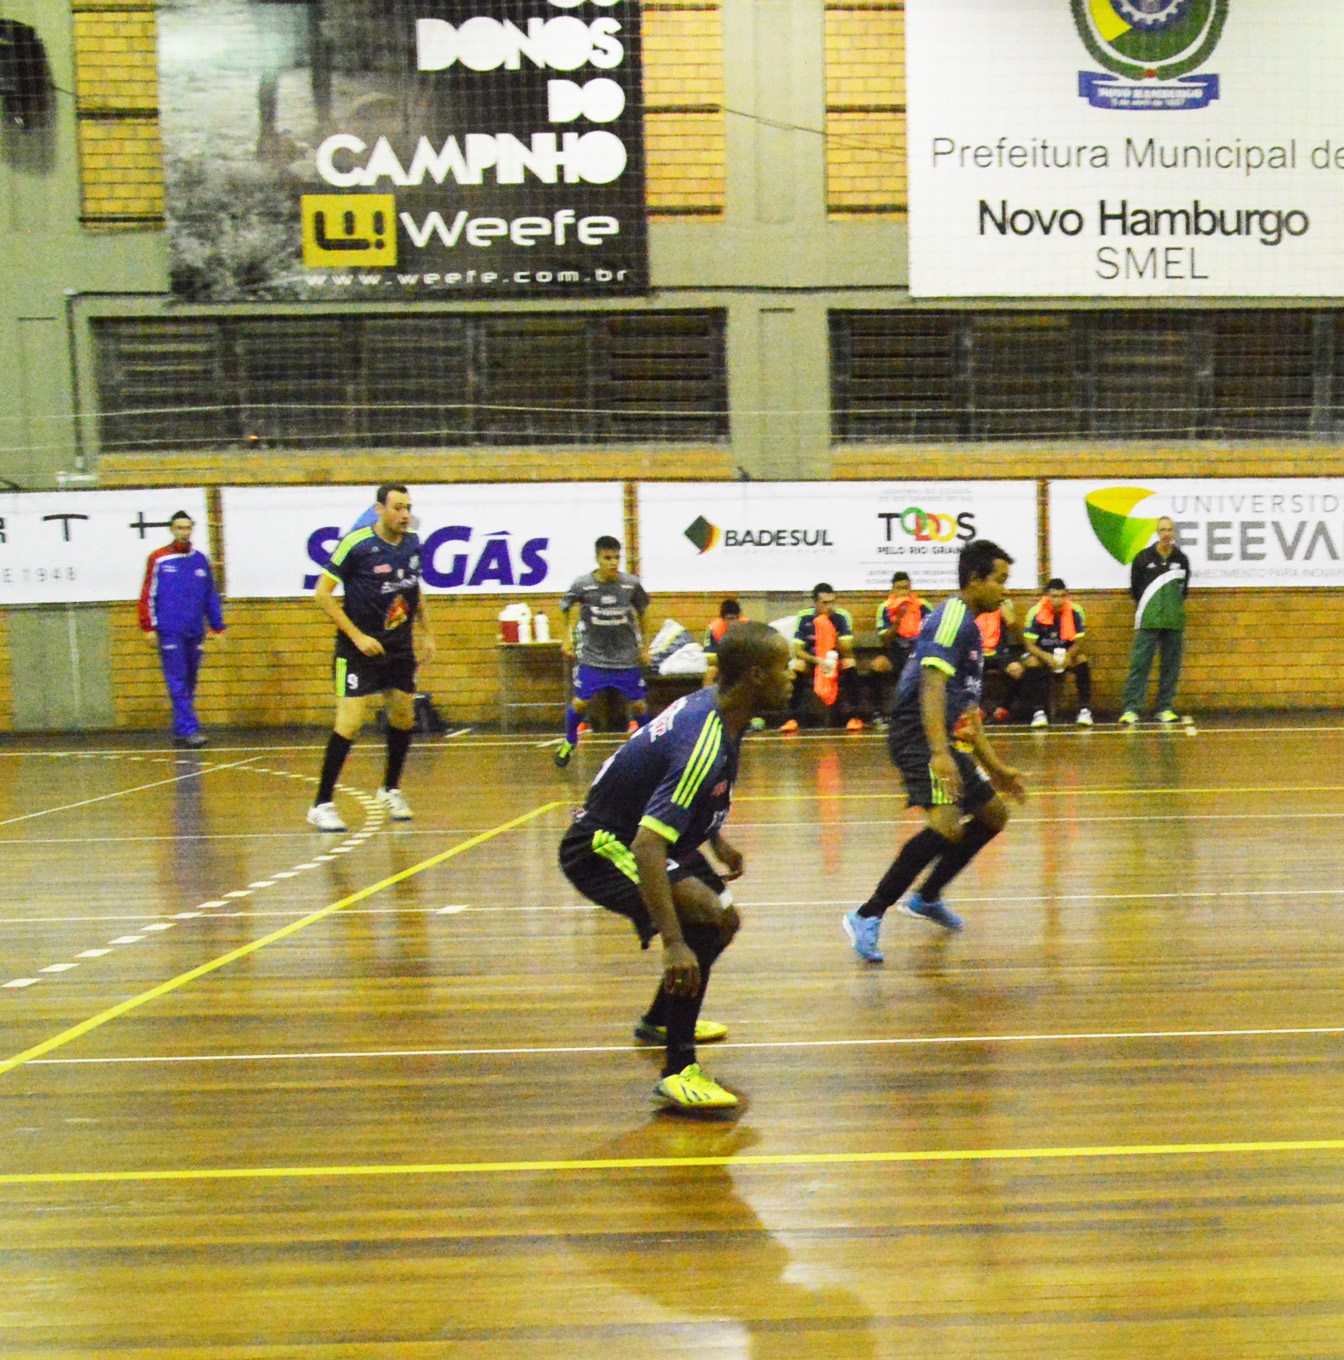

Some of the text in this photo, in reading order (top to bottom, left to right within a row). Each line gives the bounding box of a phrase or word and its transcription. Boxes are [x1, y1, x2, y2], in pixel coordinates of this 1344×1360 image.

[416, 16, 624, 71] DONOS
[548, 78, 626, 123] DO
[315, 130, 627, 187] CAMPINHO
[932, 137, 1110, 169] Prefeitura
[1125, 137, 1296, 177] Municipal
[399, 209, 620, 247] Weefe
[979, 200, 1310, 246] Novo Hamburgo
[304, 268, 627, 285] www.weefe.com.br
[1096, 247, 1209, 281] SMEL
[725, 530, 833, 546] BADESUL
[878, 507, 976, 542] TODOS
[303, 526, 550, 588] SGÁS
[877, 546, 905, 555] PELO
[910, 546, 928, 555] RIO
[1188, 567, 1265, 578] NHECIMENTO
